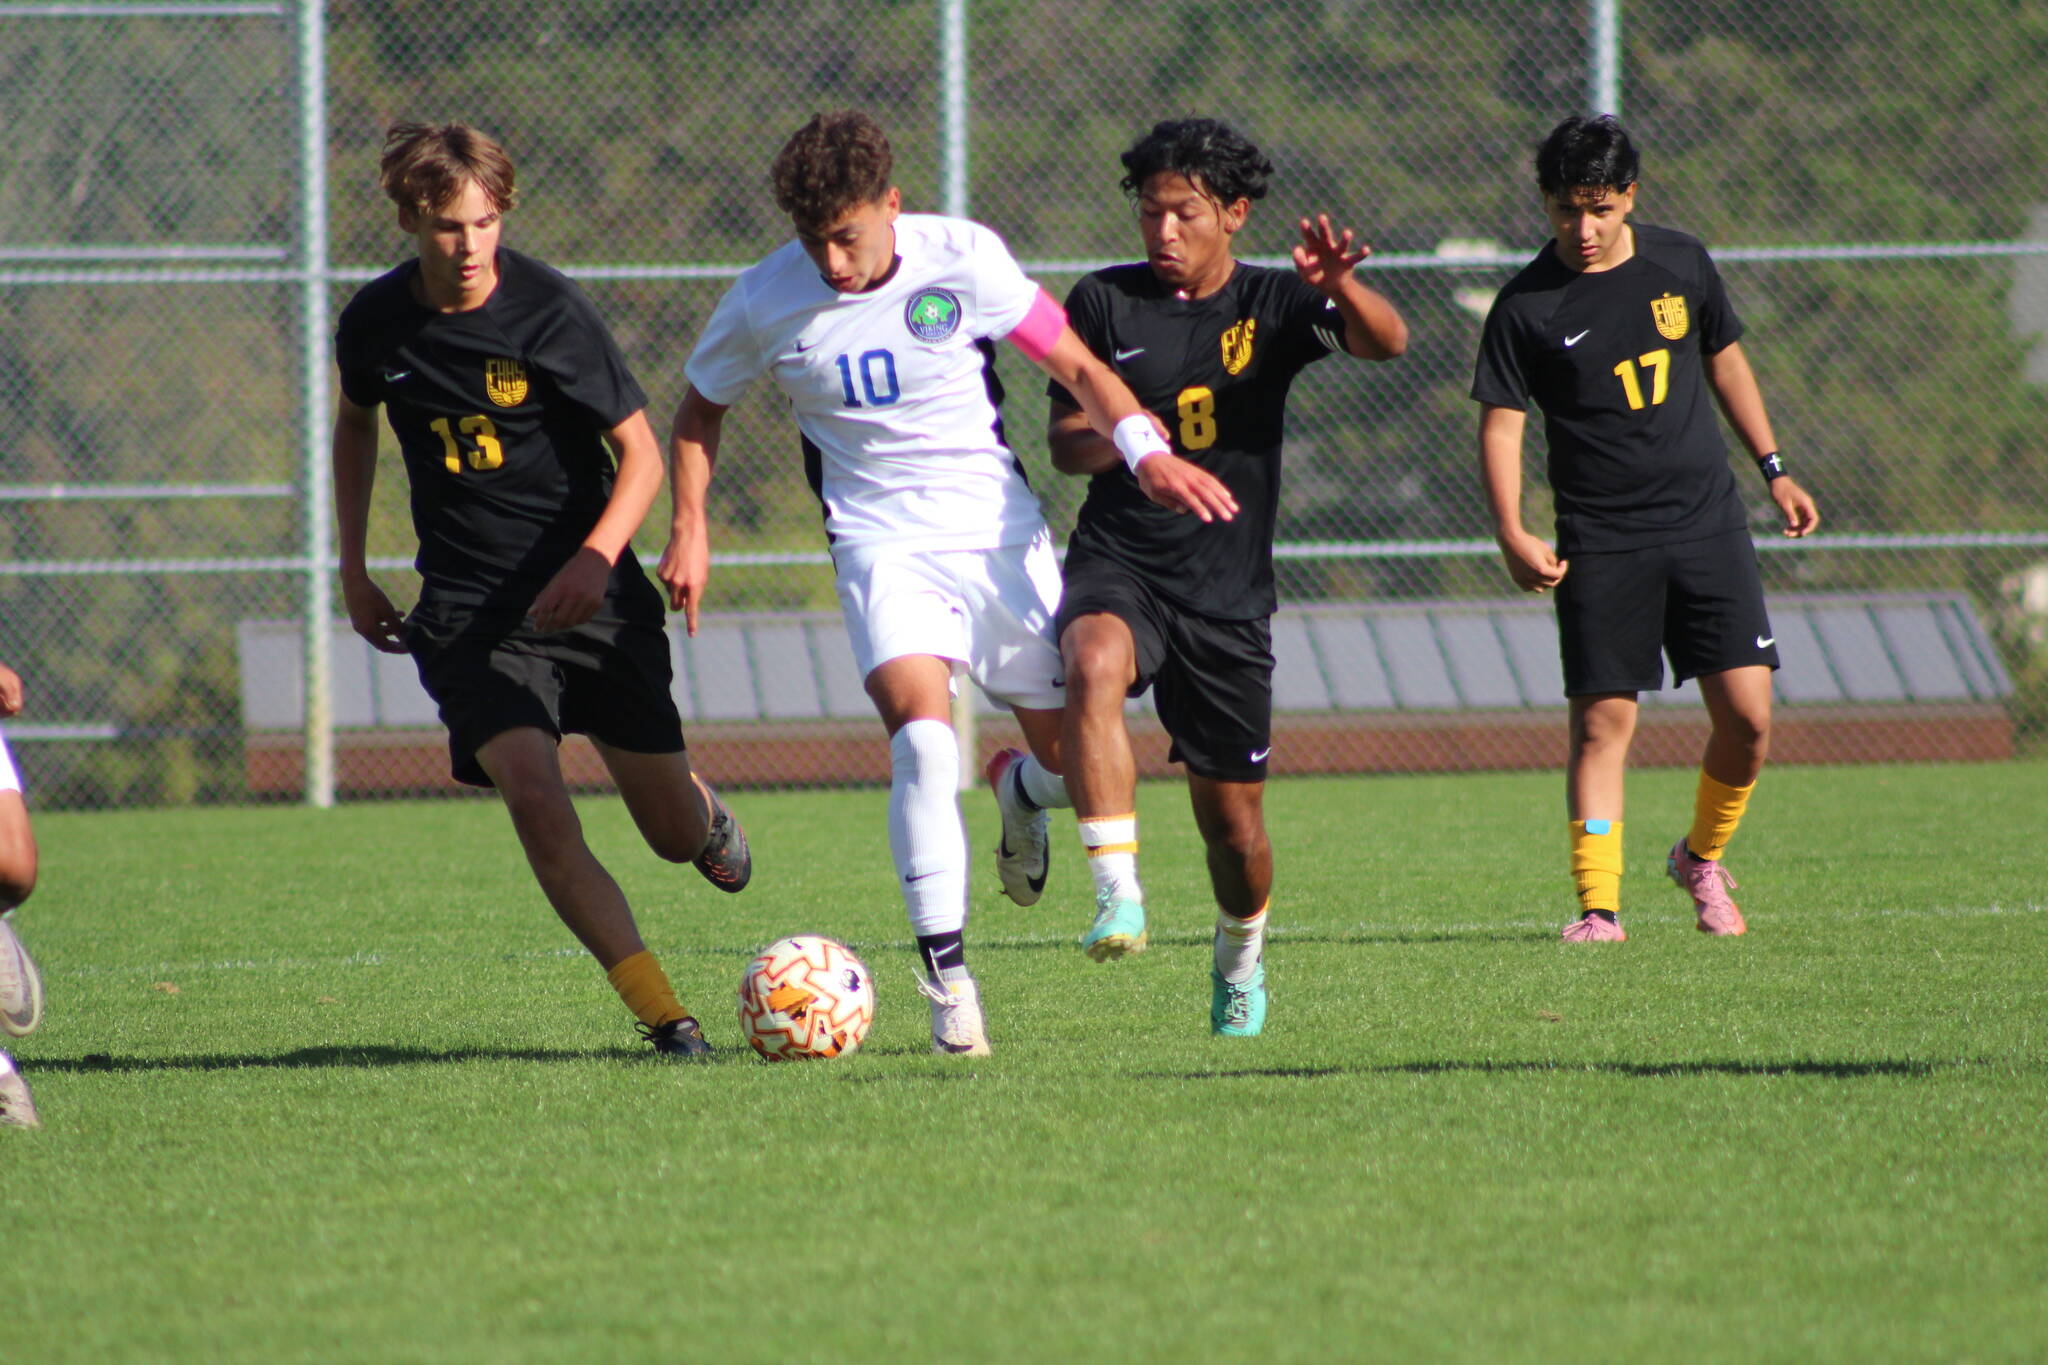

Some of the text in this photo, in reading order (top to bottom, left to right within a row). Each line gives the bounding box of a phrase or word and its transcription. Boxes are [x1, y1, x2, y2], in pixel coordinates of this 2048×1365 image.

[835, 348, 900, 408] 10
[1613, 348, 1671, 410] 17
[430, 415, 502, 474] 13
[1177, 386, 1216, 450] 8
